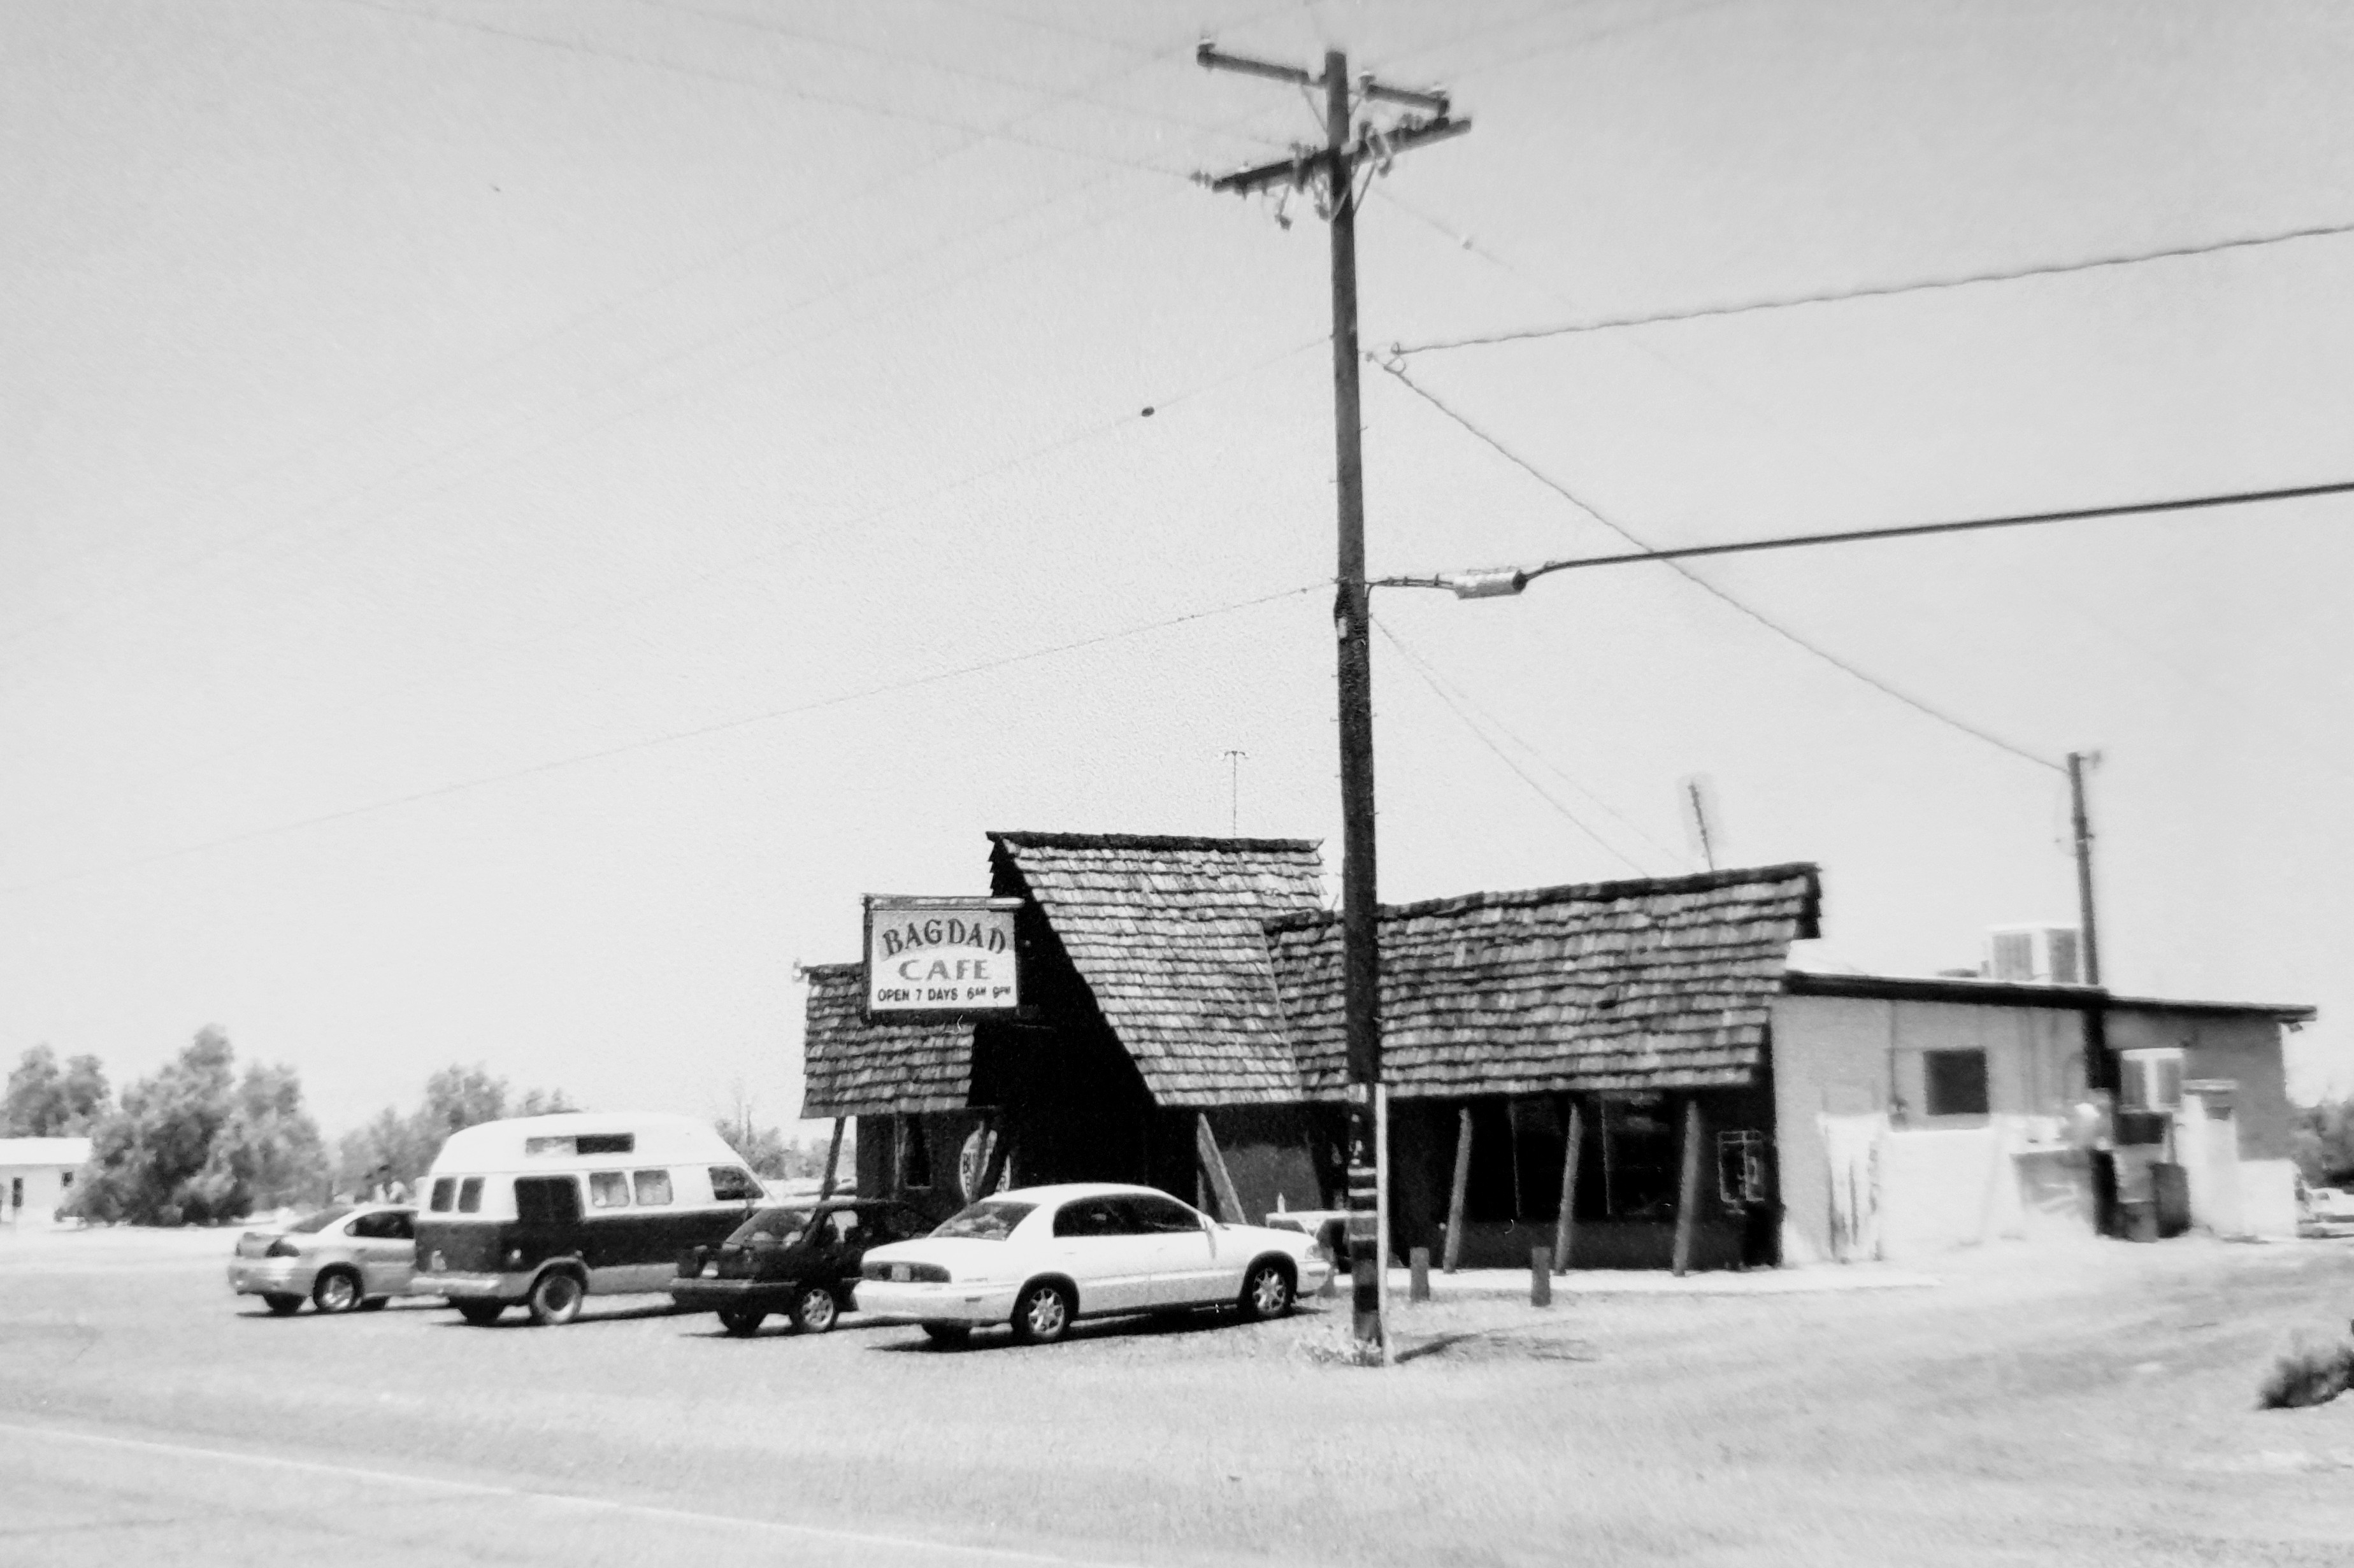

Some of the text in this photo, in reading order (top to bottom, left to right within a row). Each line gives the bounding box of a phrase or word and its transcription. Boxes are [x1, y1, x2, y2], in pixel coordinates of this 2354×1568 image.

[882, 918, 1006, 955] BAGDAD
[899, 959, 990, 980] CAFE
[878, 988, 909, 1001] OPEN
[916, 989, 922, 1001] 7
[928, 988, 958, 1001] DAYS
